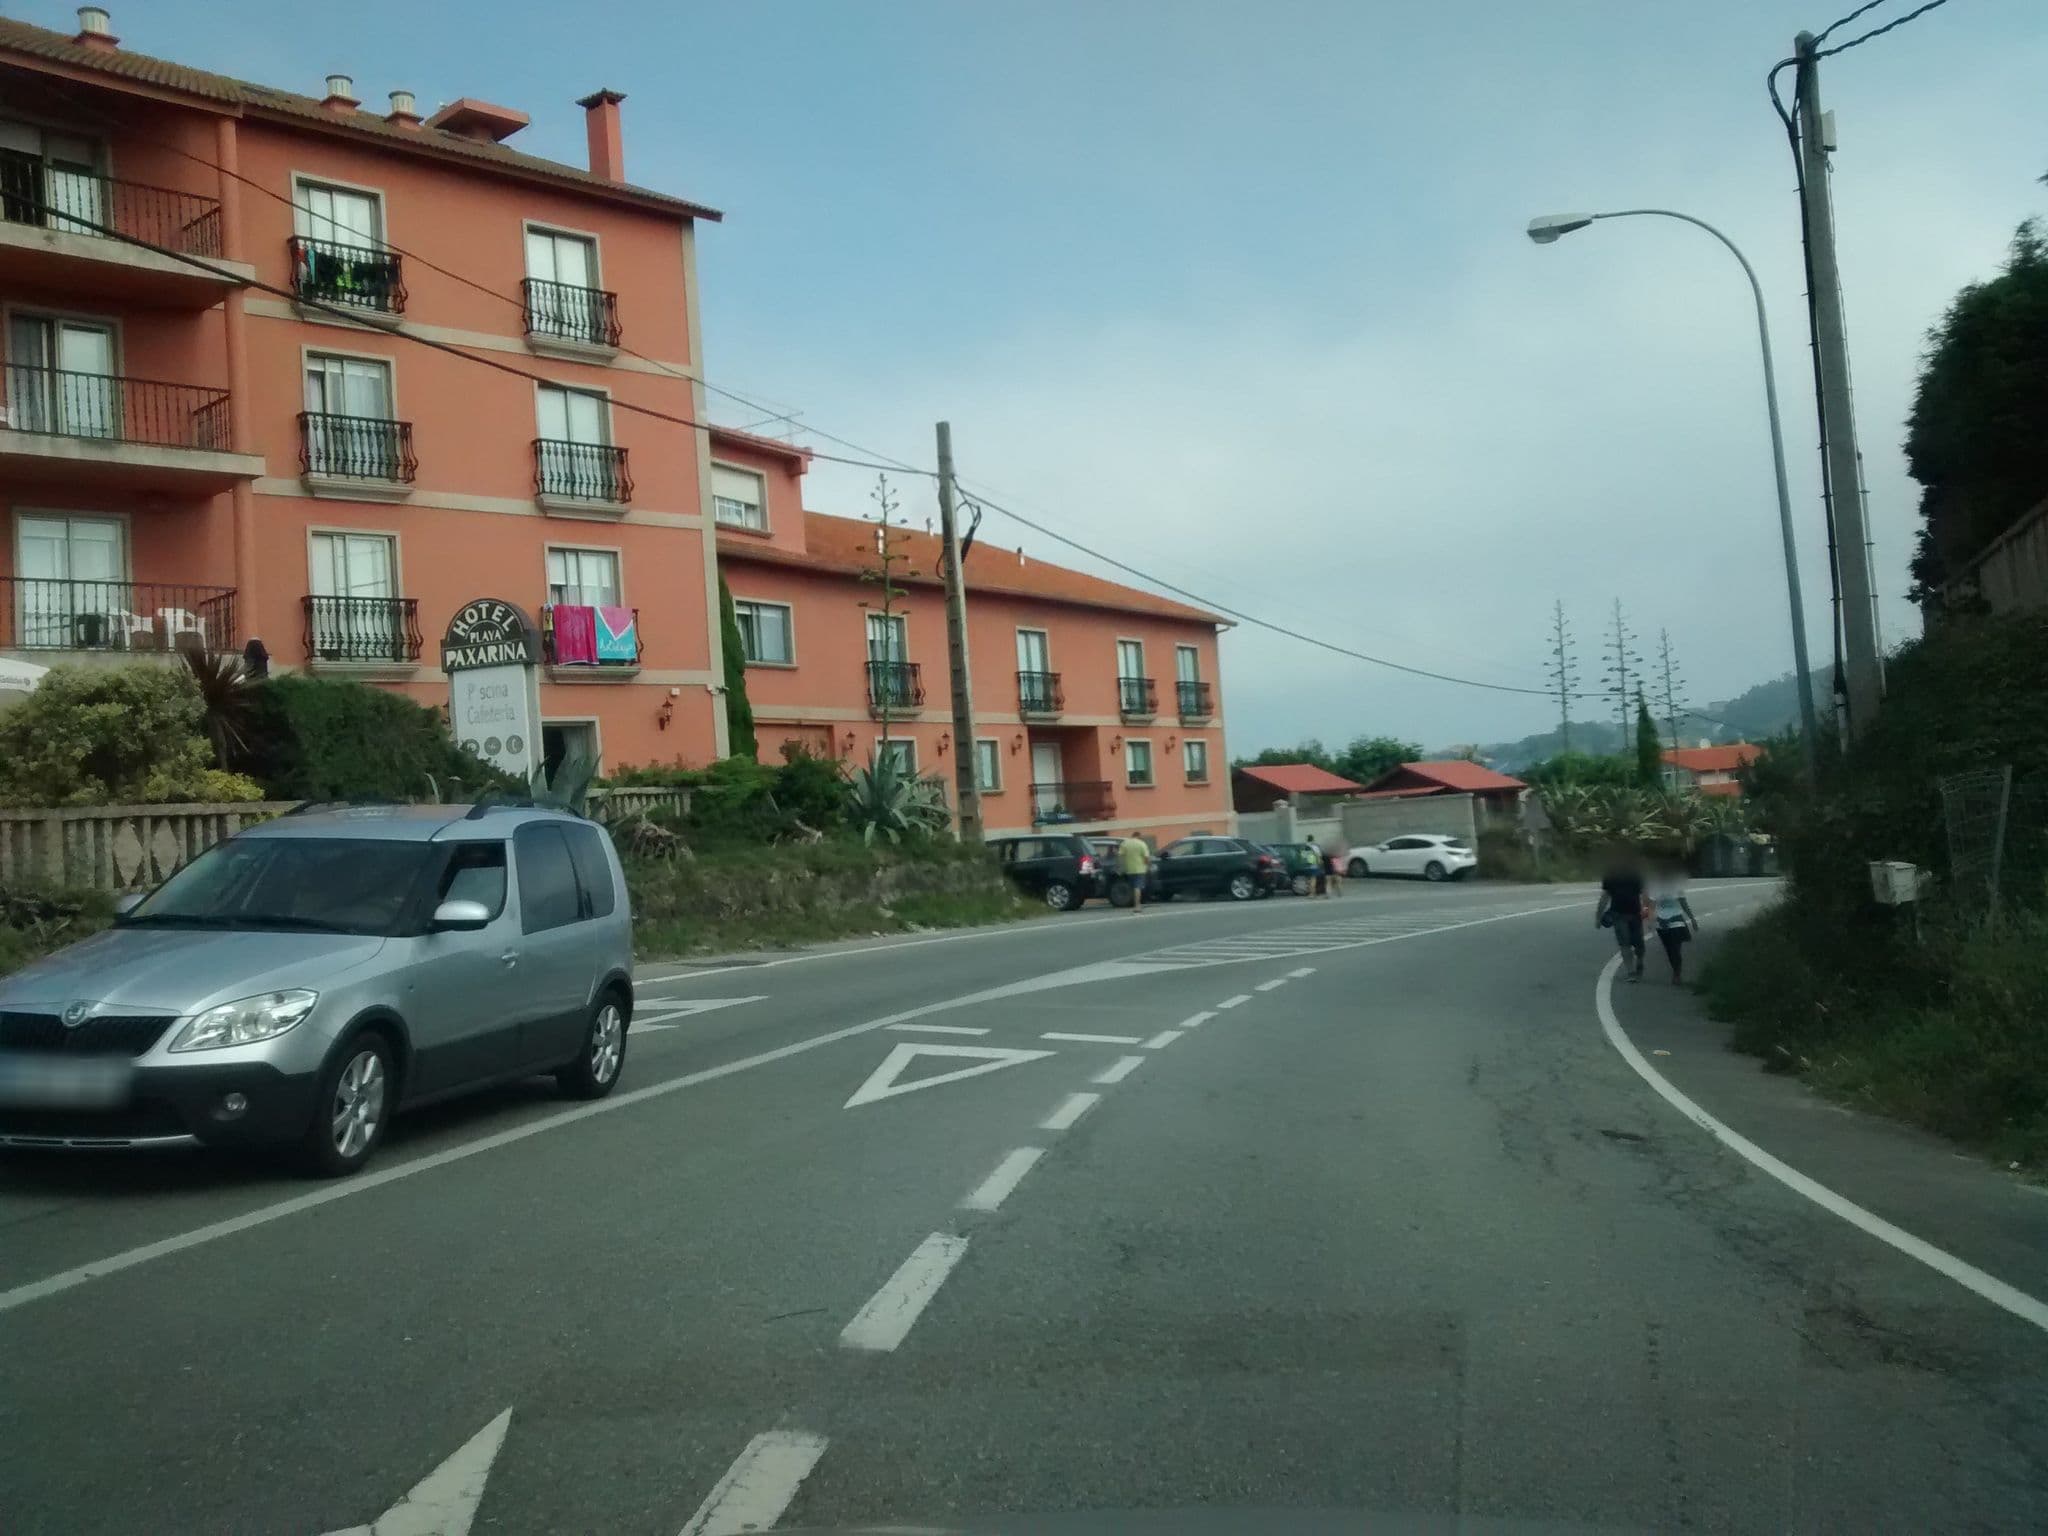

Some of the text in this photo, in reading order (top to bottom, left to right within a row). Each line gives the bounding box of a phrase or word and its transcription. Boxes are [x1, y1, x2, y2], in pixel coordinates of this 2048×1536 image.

[453, 603, 514, 637] HOTEL
[470, 630, 502, 643] PLAYA
[467, 682, 509, 701] Pscina
